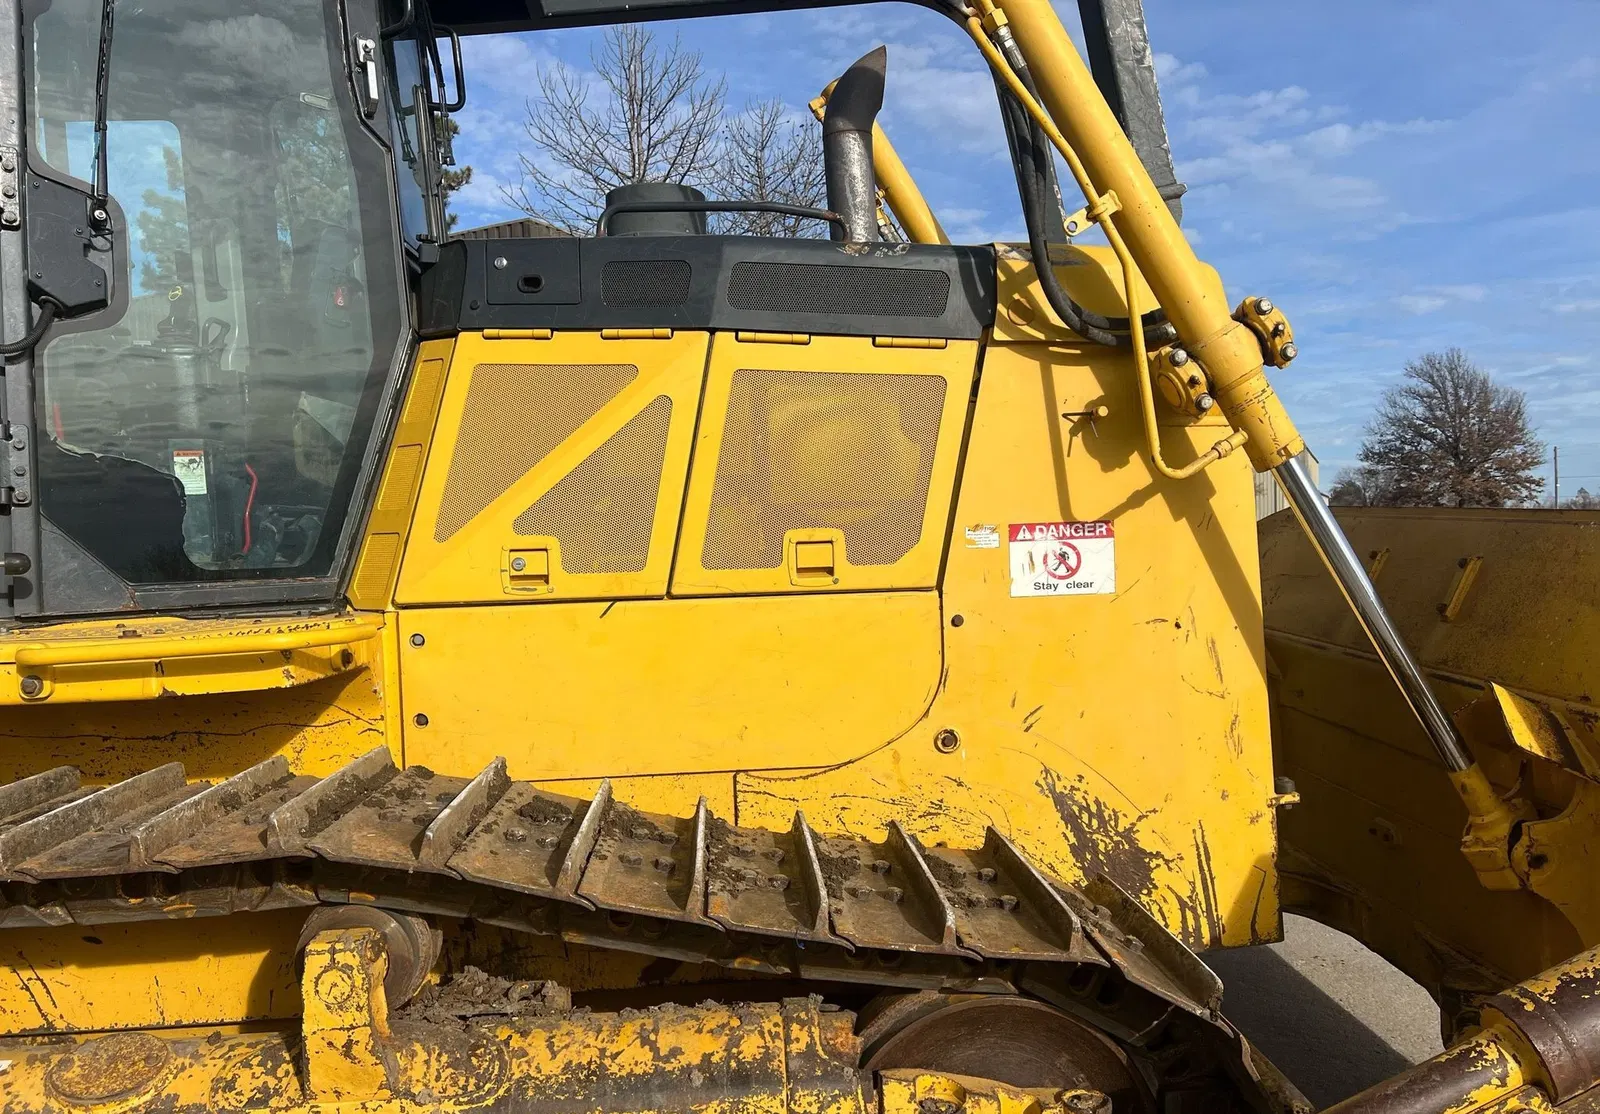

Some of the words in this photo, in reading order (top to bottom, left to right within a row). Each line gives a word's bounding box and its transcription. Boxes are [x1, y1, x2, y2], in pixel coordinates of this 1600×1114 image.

[1035, 523, 1107, 538] DANGER
[1034, 582, 1059, 591] Stay
[1066, 581, 1094, 589] clear
